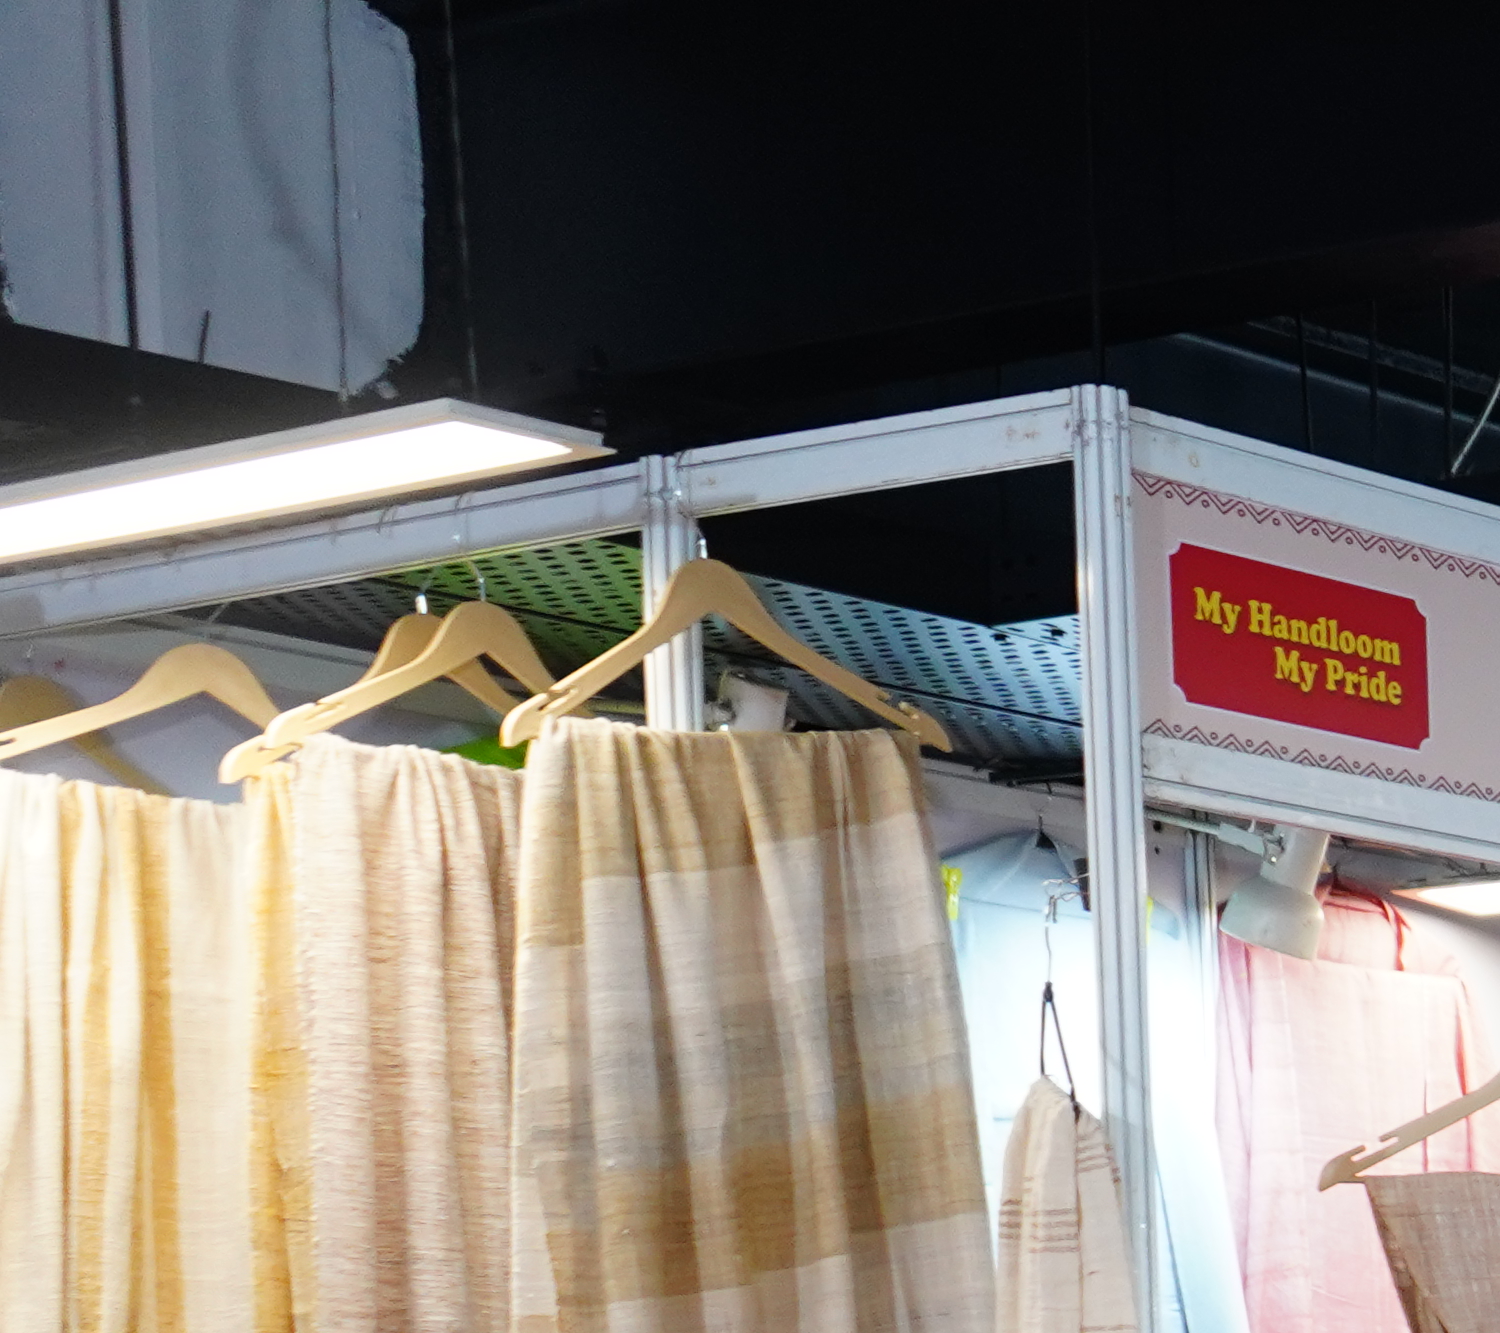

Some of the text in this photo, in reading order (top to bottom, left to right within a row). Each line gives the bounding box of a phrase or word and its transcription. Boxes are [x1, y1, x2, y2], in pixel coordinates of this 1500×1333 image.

[1193, 586, 1401, 666] My Handloom
[1273, 646, 1402, 706] My Pride
